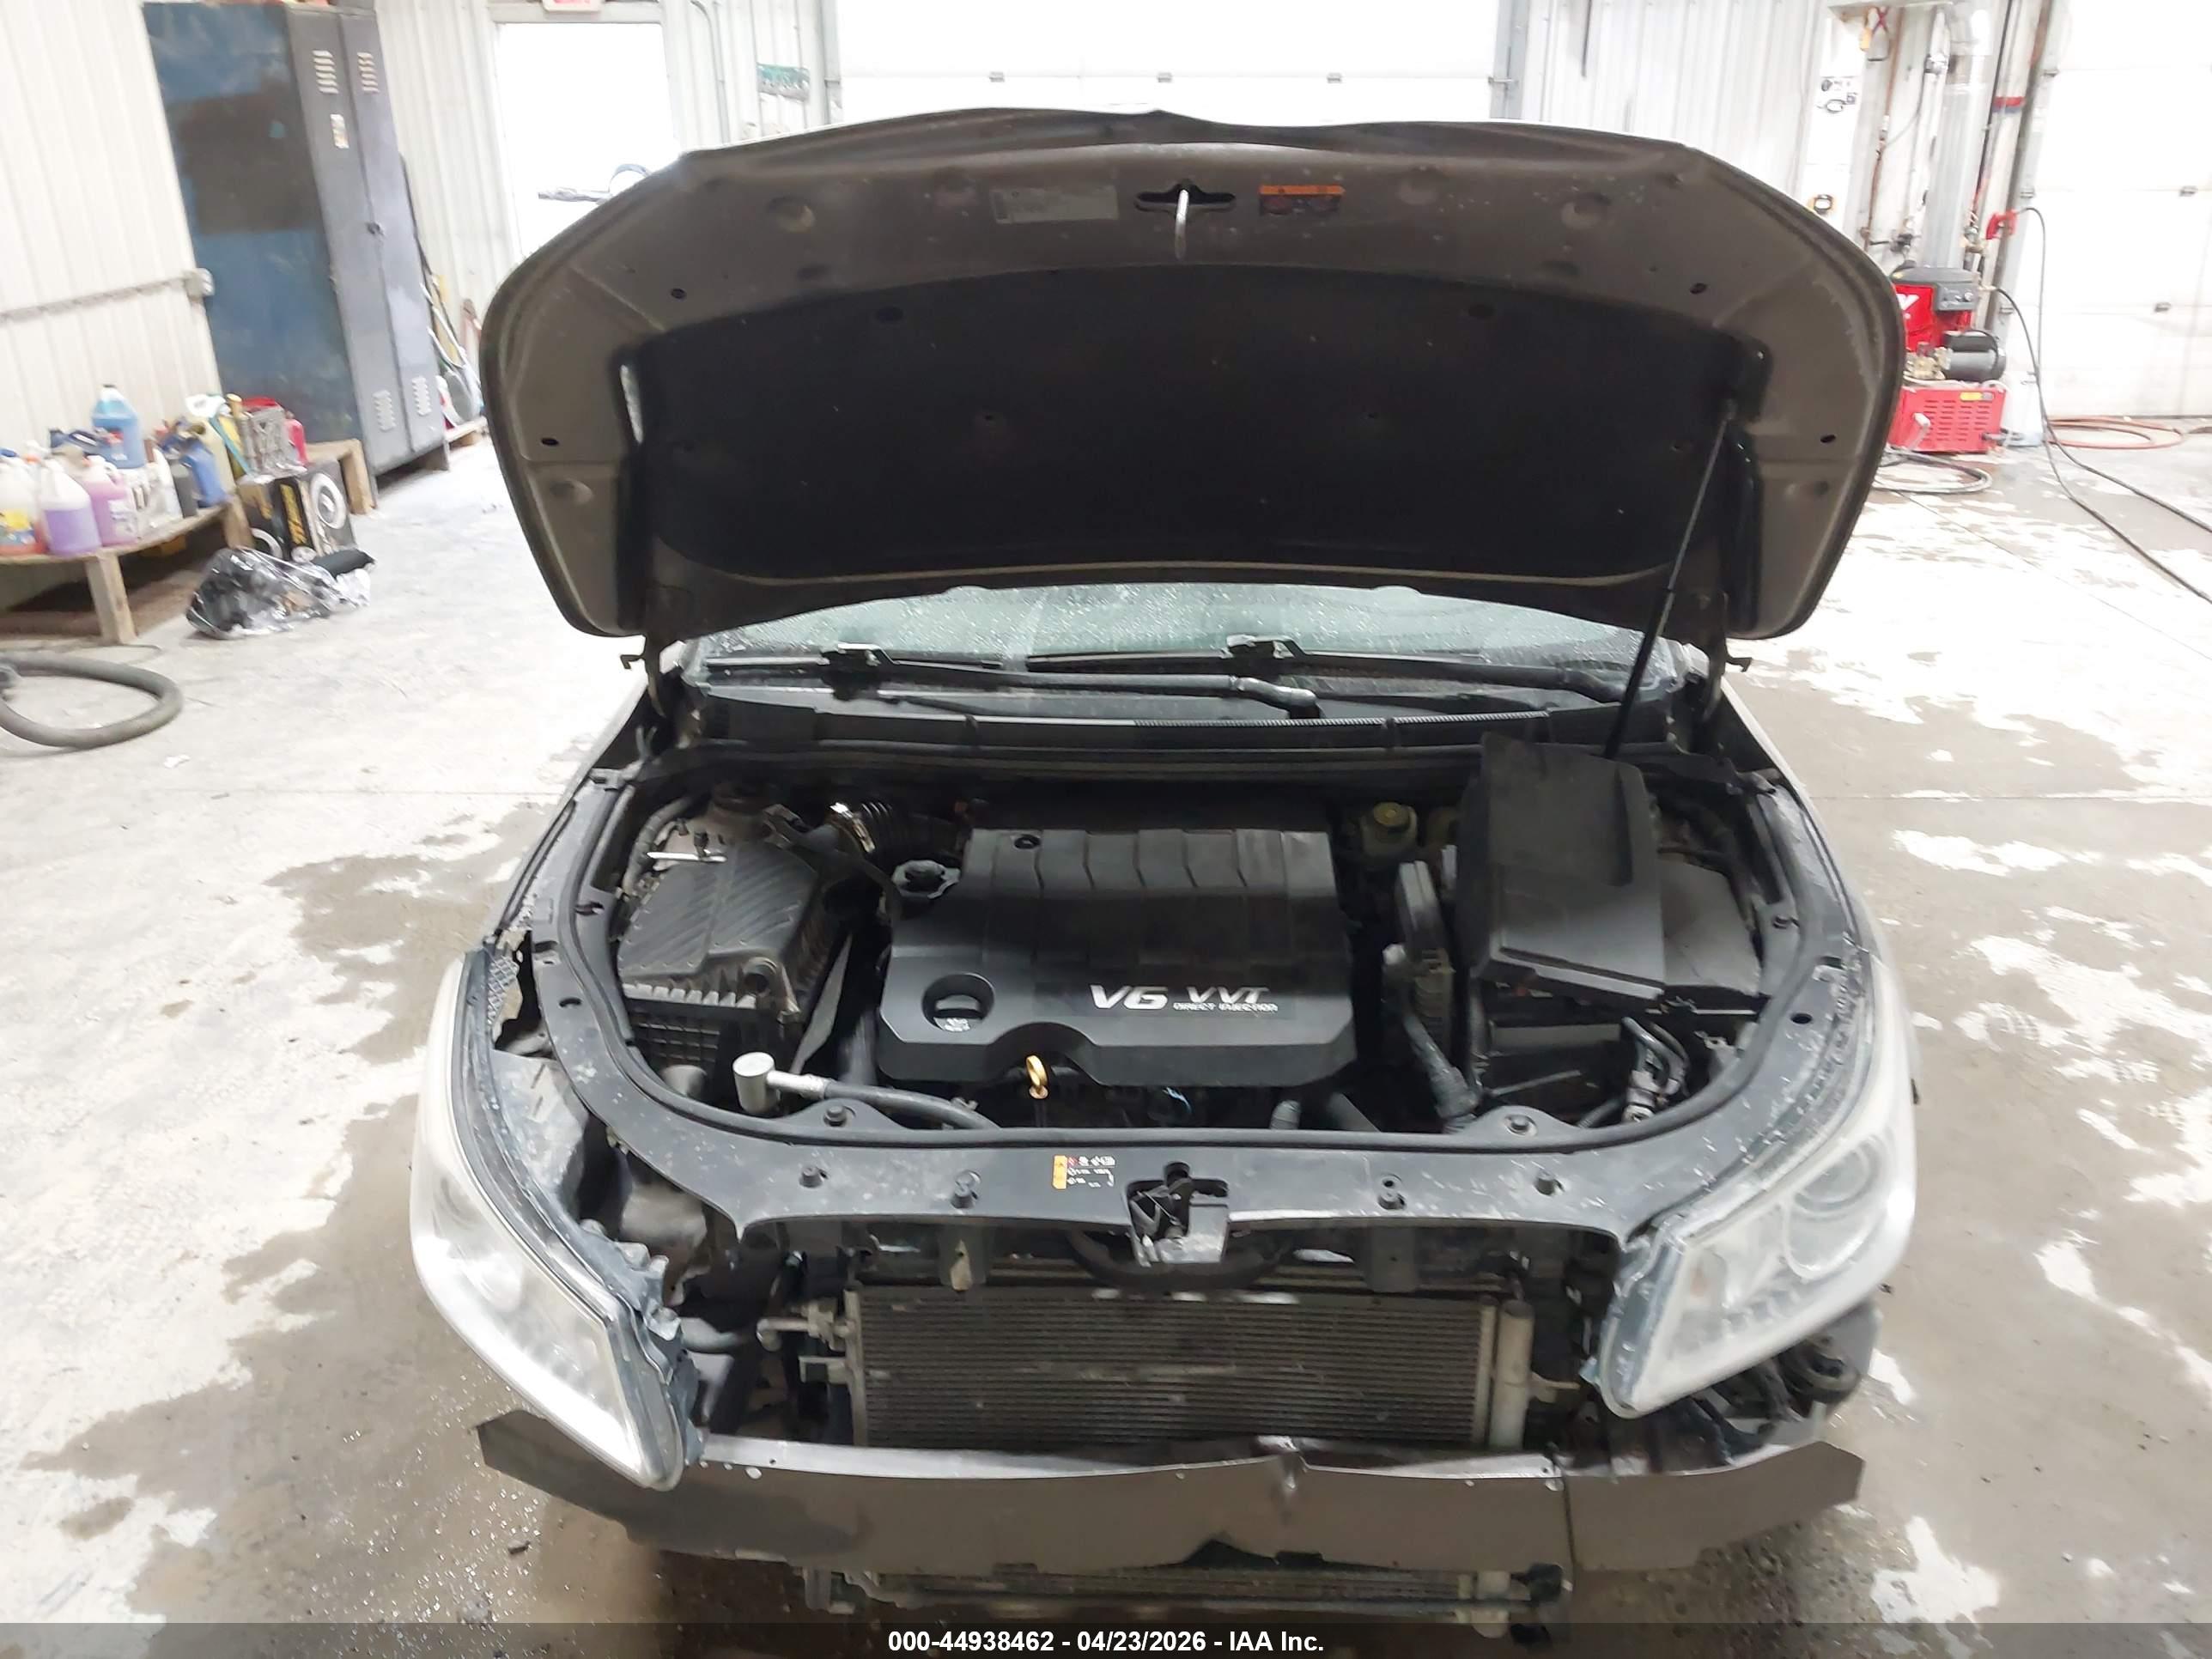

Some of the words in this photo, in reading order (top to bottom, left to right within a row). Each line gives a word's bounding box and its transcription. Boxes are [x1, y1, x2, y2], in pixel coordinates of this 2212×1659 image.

[1090, 985, 1169, 1009] V6
[1187, 987, 1270, 1003] VVT
[1173, 1002, 1216, 1012] DIRECT
